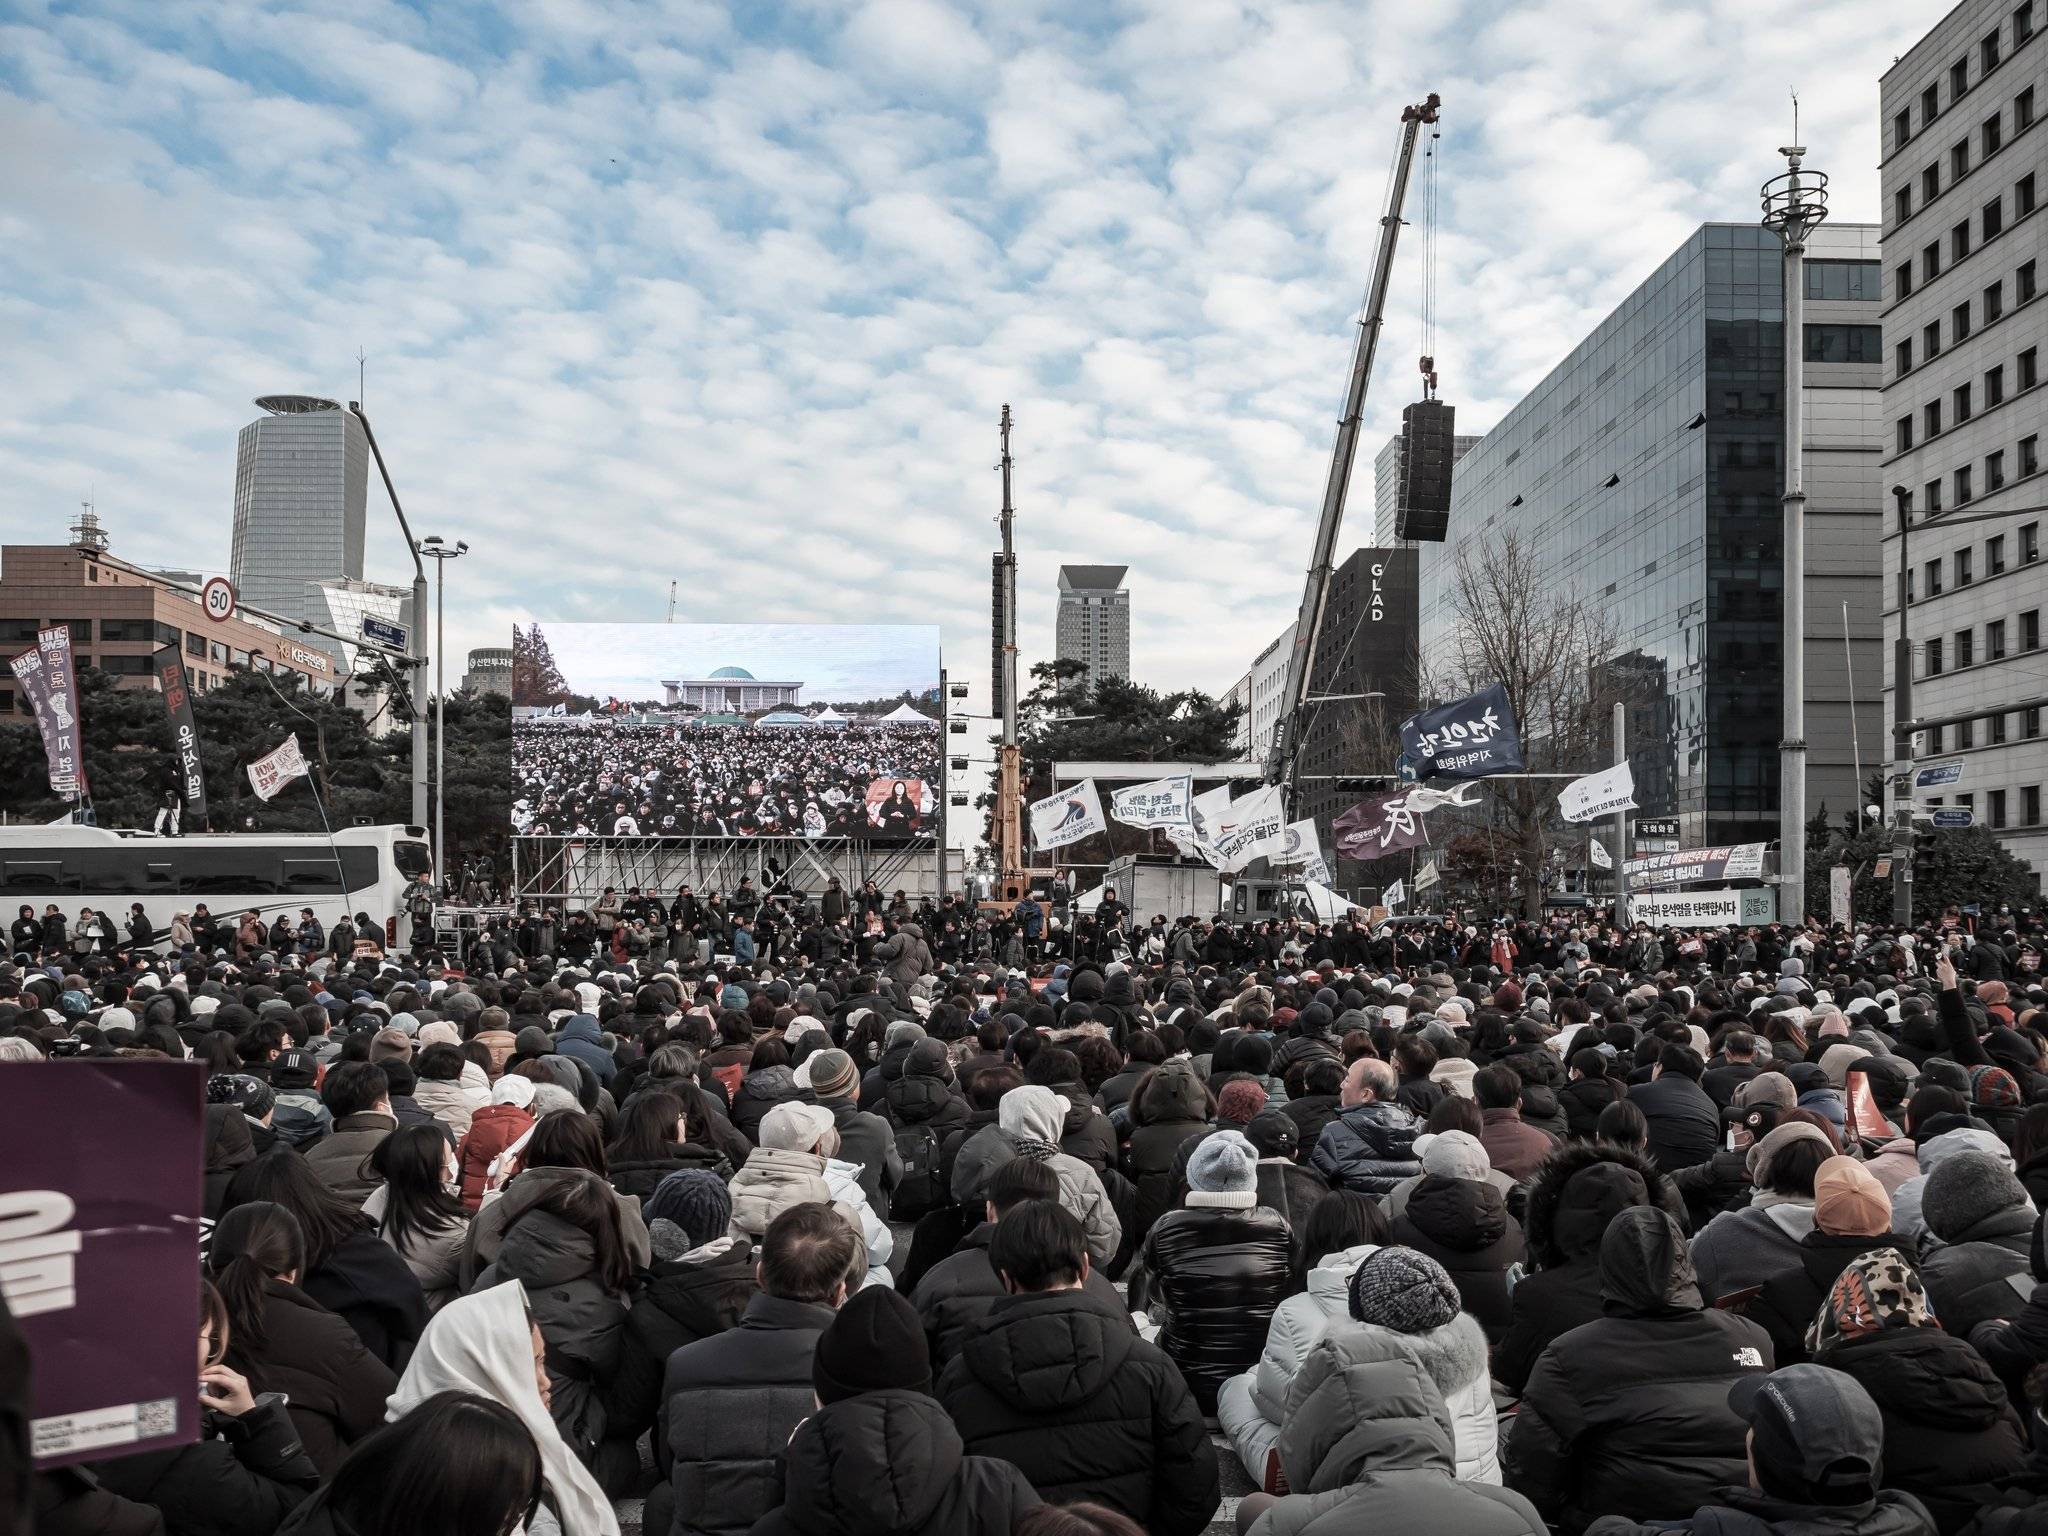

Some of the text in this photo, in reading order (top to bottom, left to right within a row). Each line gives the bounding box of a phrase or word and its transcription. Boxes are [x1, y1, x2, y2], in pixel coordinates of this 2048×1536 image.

[210, 589, 228, 611] 50
[1371, 563, 1383, 621] GLAD
[291, 647, 327, 672] KB국민은행
[1641, 824, 1675, 834] 국회화원
[1635, 900, 1736, 918] 내란수괴 윤석열을 탄핵합시다
